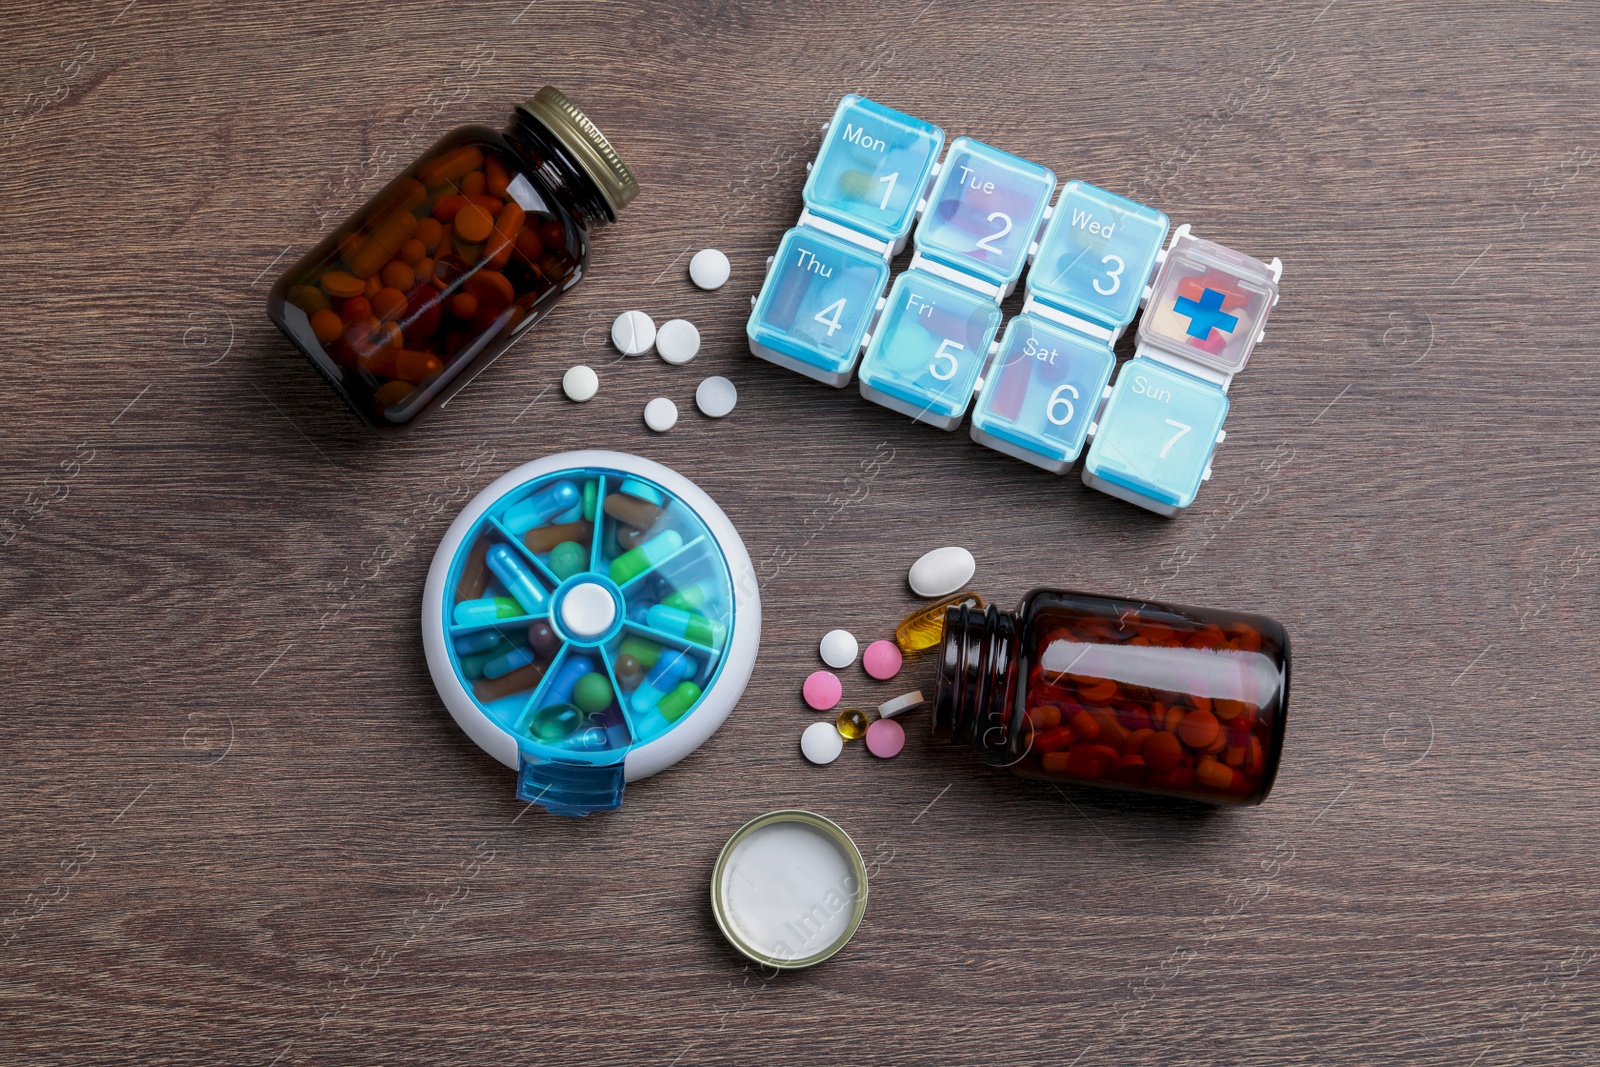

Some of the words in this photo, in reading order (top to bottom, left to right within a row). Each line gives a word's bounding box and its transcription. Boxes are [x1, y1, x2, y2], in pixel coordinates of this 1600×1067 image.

[842, 123, 886, 153] Mon
[879, 172, 899, 210] 1
[959, 165, 995, 195] Tue
[975, 212, 1013, 256] 2
[1071, 208, 1116, 239] Wed
[797, 248, 833, 278] Thu
[1092, 254, 1125, 296] 3
[813, 297, 847, 337] 4
[905, 293, 936, 318] Fri
[929, 338, 964, 381] 5
[1023, 337, 1058, 365] Sat
[1046, 384, 1080, 426] 6
[1131, 375, 1172, 404] Sun
[1158, 418, 1192, 460] 7
